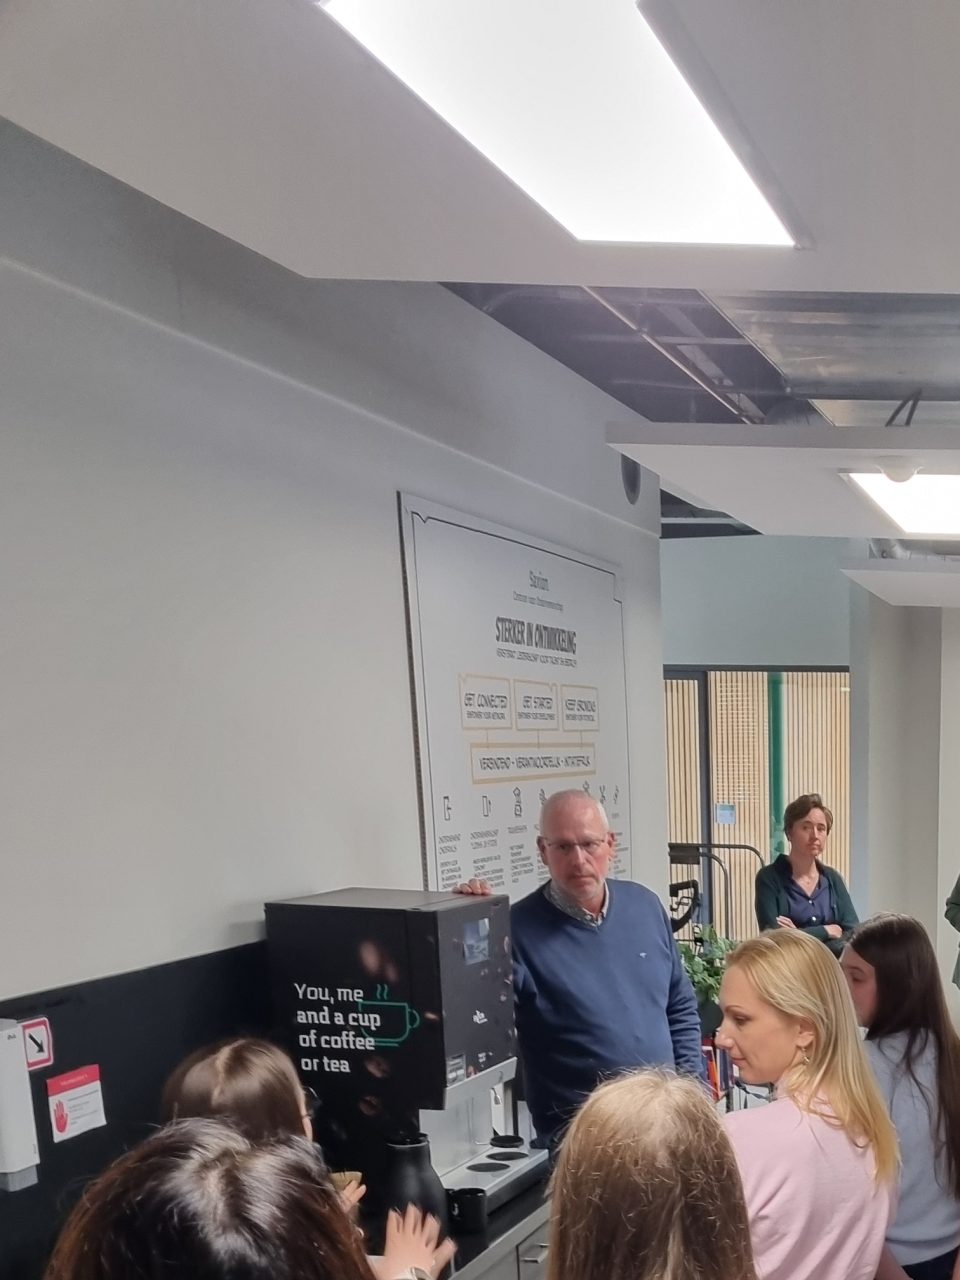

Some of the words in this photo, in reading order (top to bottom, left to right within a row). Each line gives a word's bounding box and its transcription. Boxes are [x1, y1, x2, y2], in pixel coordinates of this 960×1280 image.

[496, 616, 525, 646] STERKER
[526, 621, 534, 647] IN
[293, 983, 334, 1005] You,
[336, 988, 364, 1002] me
[296, 1005, 331, 1025] and
[334, 1011, 345, 1025] a
[348, 1012, 381, 1031] cup
[298, 1029, 317, 1048] of
[320, 1030, 376, 1051] coffee
[301, 1058, 320, 1072] or
[322, 1056, 351, 1073] tea
